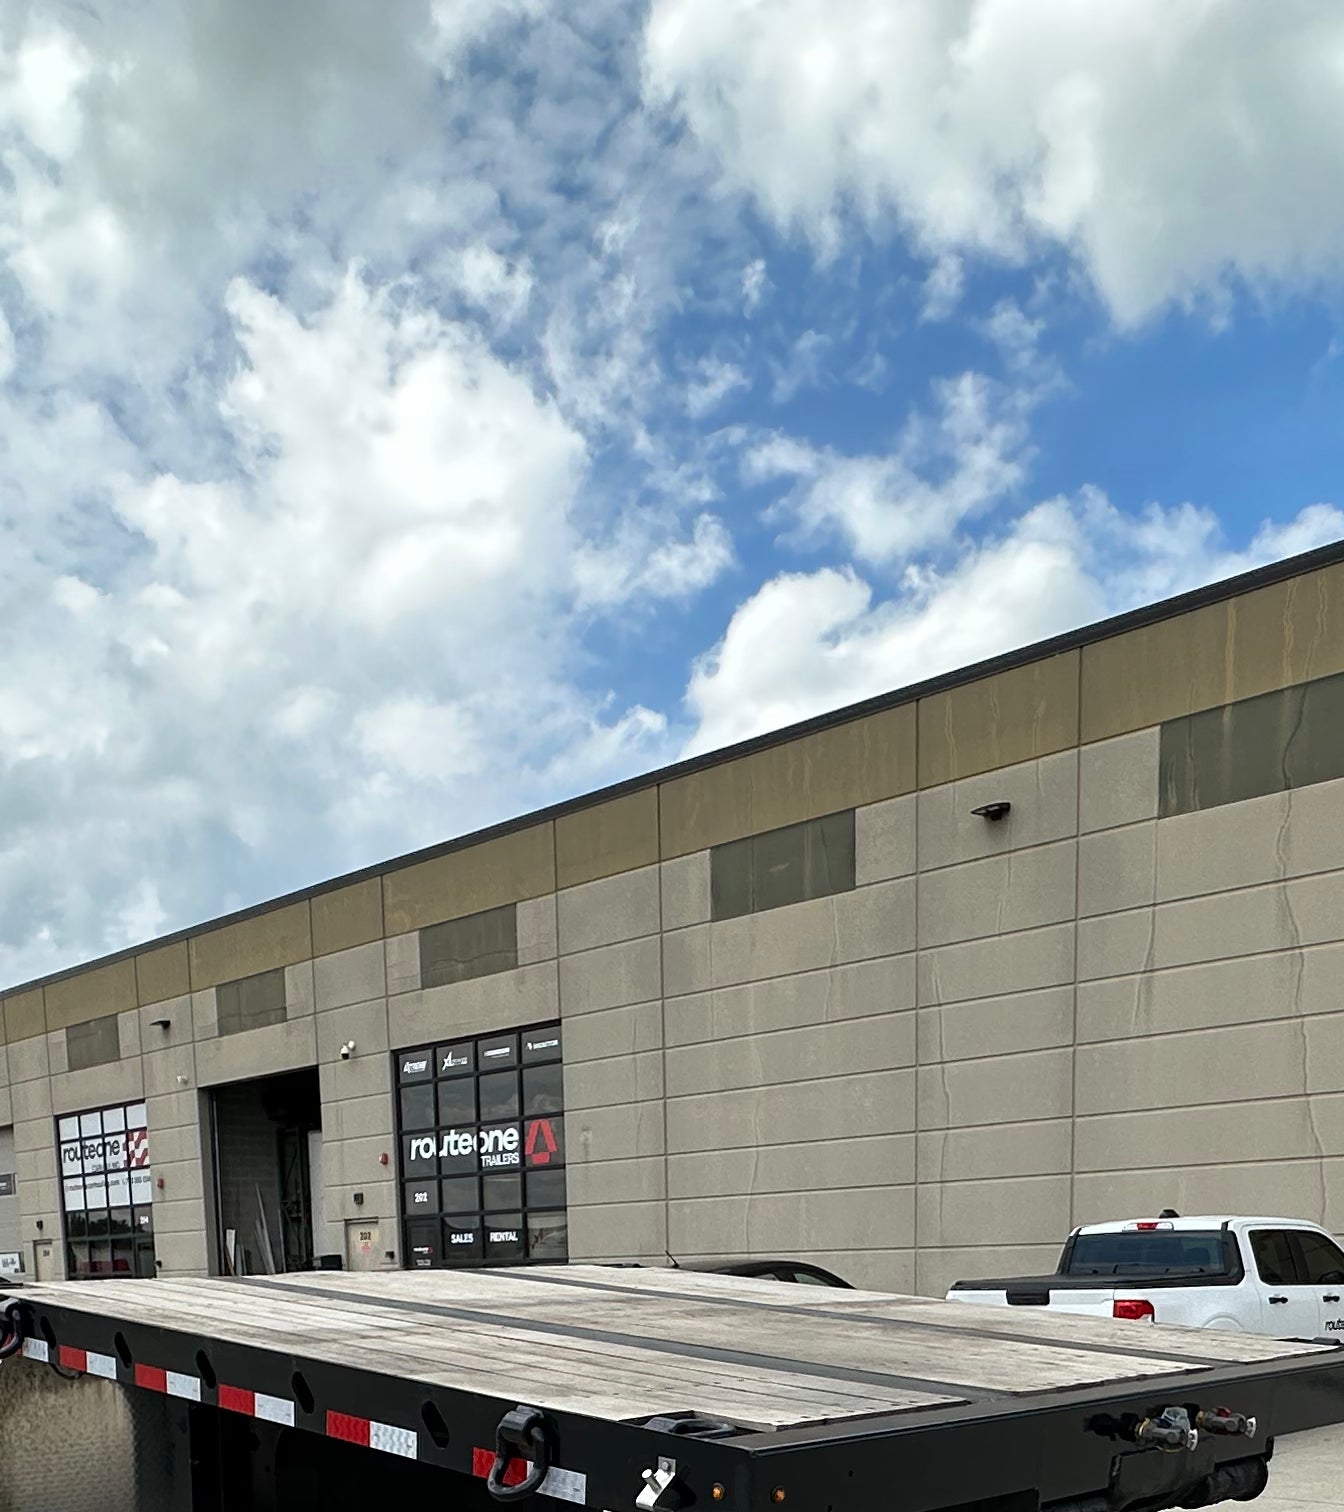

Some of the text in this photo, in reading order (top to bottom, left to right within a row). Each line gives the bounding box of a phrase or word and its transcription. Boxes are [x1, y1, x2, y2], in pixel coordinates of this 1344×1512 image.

[480, 1152, 520, 1168] TRAILERS
[451, 1232, 474, 1244] SALES
[489, 1231, 519, 1243] RENTAL
